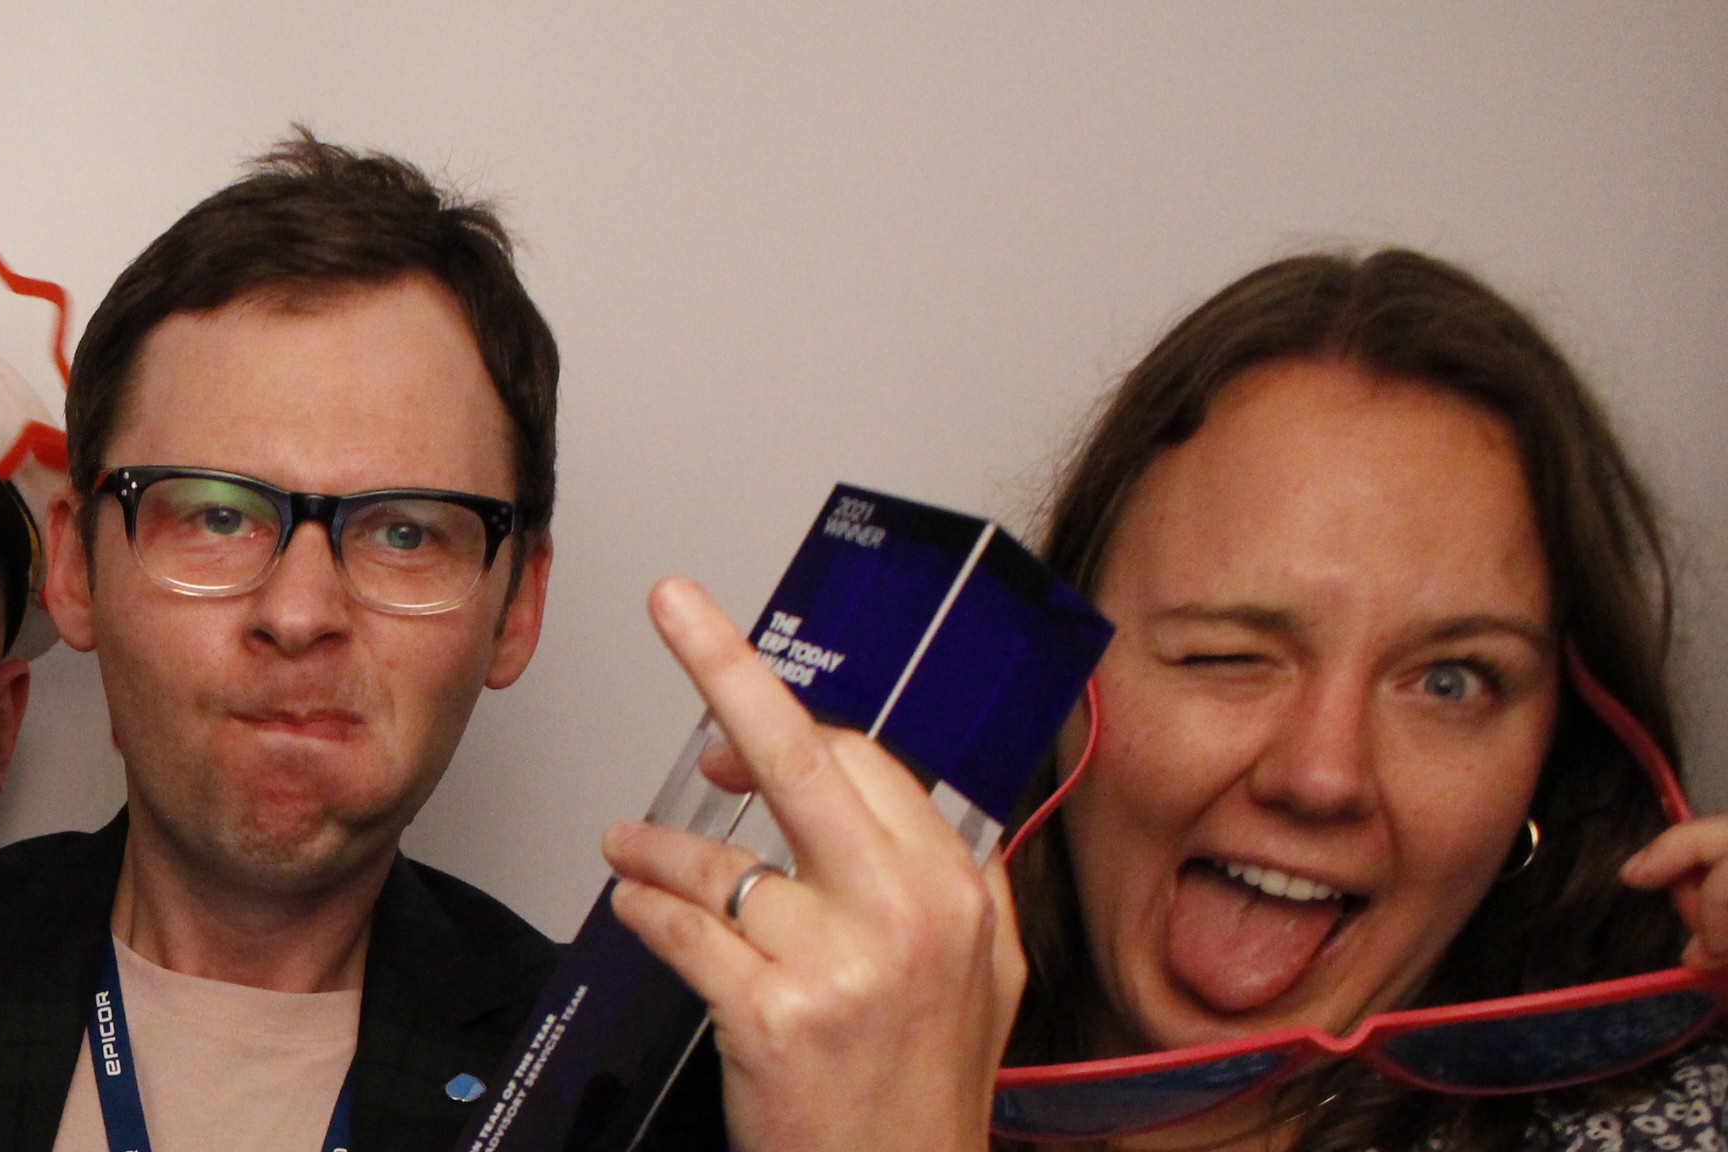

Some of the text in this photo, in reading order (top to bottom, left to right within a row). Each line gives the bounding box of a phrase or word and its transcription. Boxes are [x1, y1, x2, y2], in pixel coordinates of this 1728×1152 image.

[770, 610, 803, 636] THE
[757, 629, 846, 674] ERP TODAY
[758, 651, 818, 688] WARDS
[524, 1023, 566, 1088] SERVICES
[561, 985, 588, 1021] TEAM
[479, 1102, 507, 1139] TEAM
[502, 1079, 517, 1101] OF
[513, 1052, 535, 1078] THE
[530, 1013, 558, 1049] YEAR
